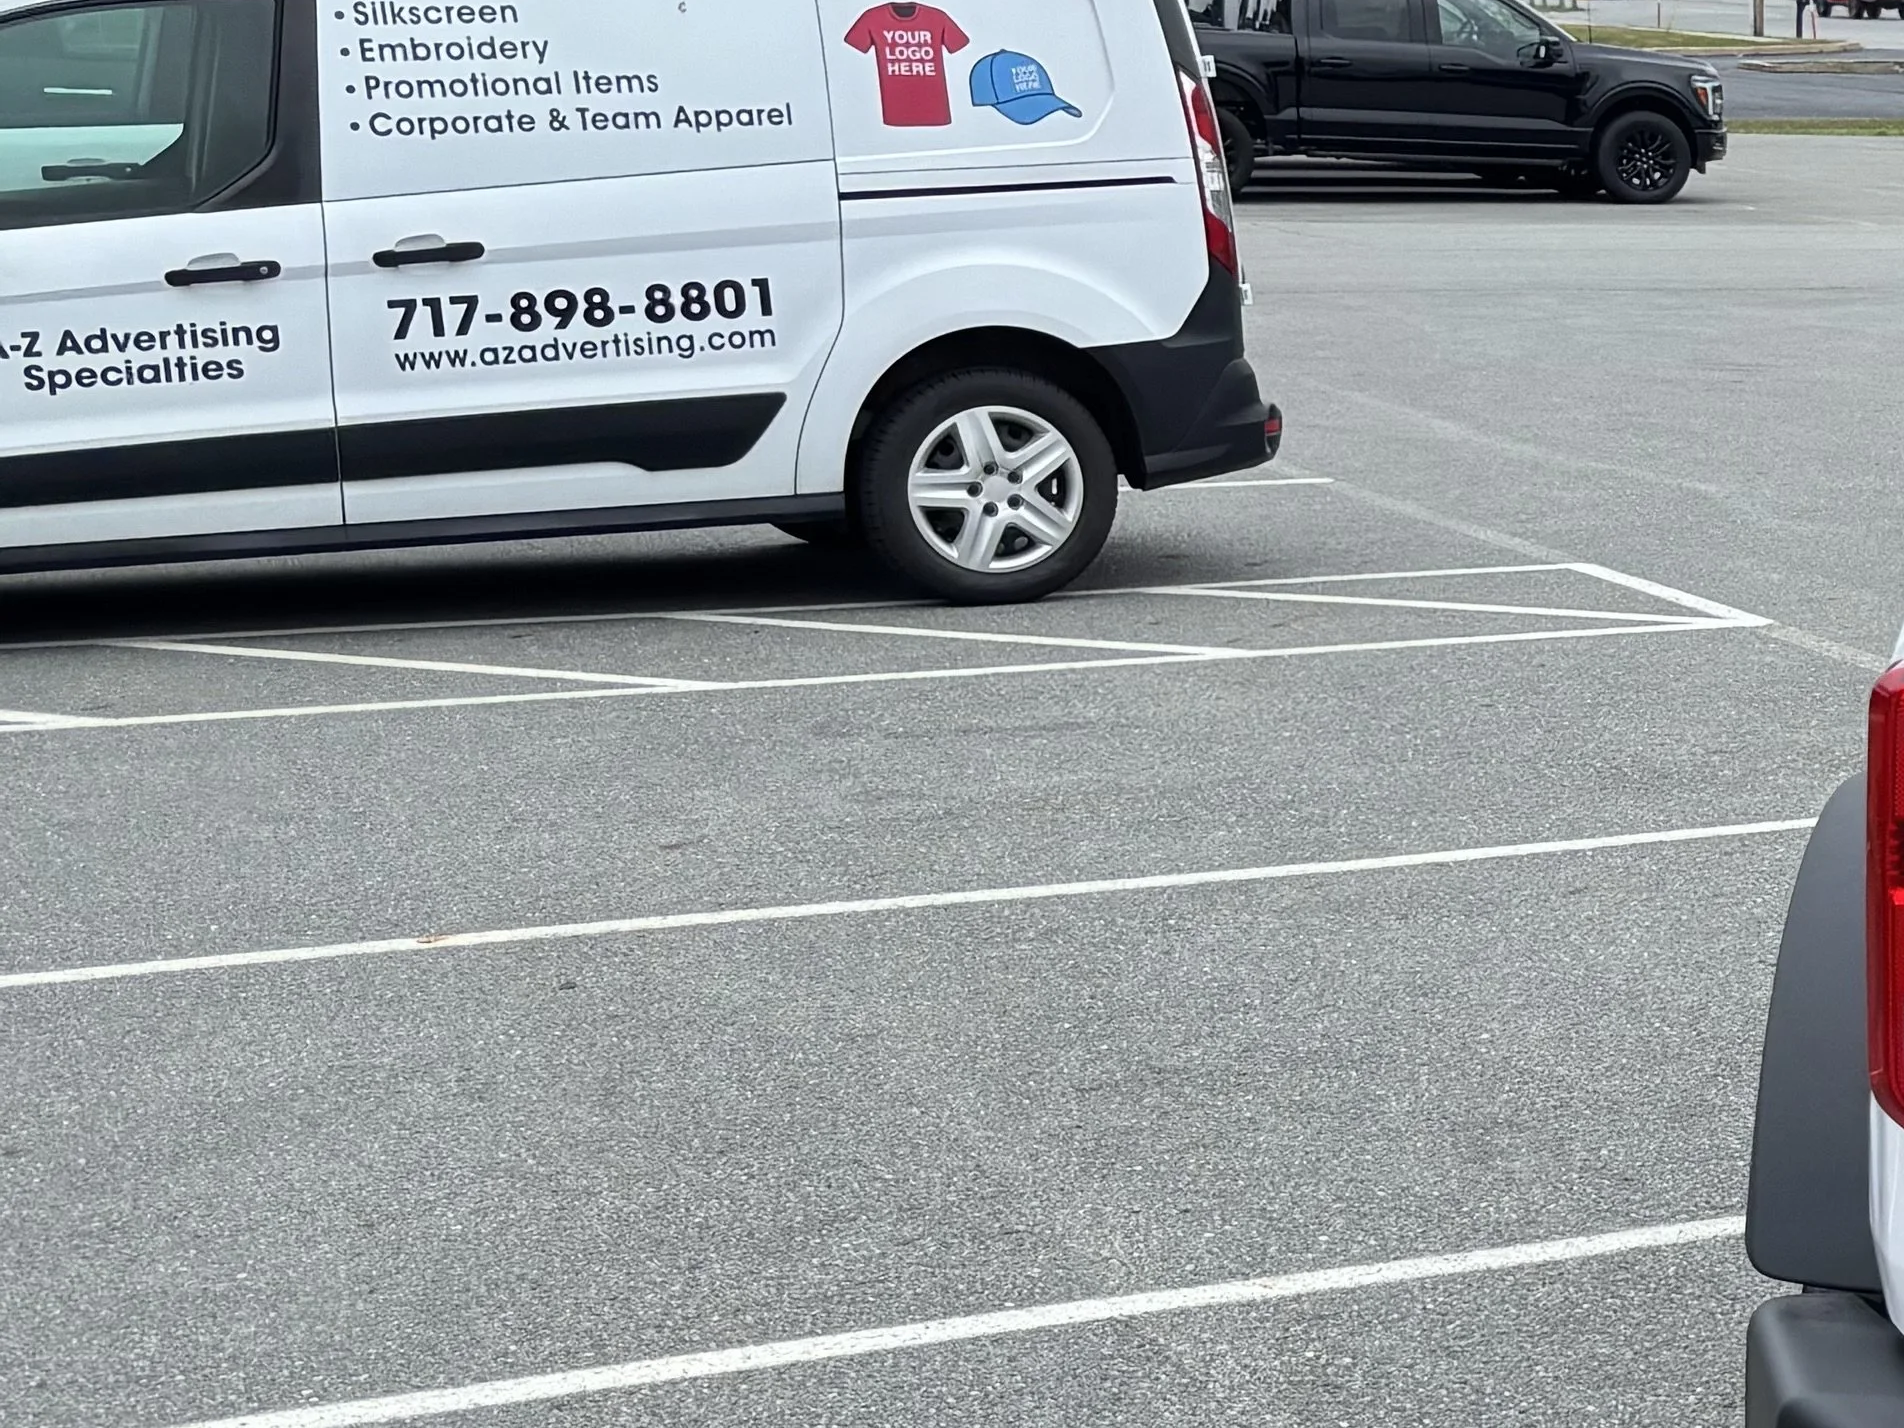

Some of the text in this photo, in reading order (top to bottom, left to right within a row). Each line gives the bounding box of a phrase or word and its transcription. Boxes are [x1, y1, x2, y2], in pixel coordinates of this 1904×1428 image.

[353, 0, 519, 26] Silkscreen
[359, 36, 549, 64] Embroidery
[883, 30, 932, 44] YOUR
[886, 46, 934, 60] LOGO
[887, 62, 936, 76] HERE
[365, 70, 659, 100] Promotional Items
[368, 102, 793, 140] Corporate & Team Apparel
[387, 278, 773, 340] 717-898-8801
[56, 321, 280, 353] Advertising
[394, 327, 776, 372] www.azadvertising.com
[24, 356, 244, 396] Specialties
